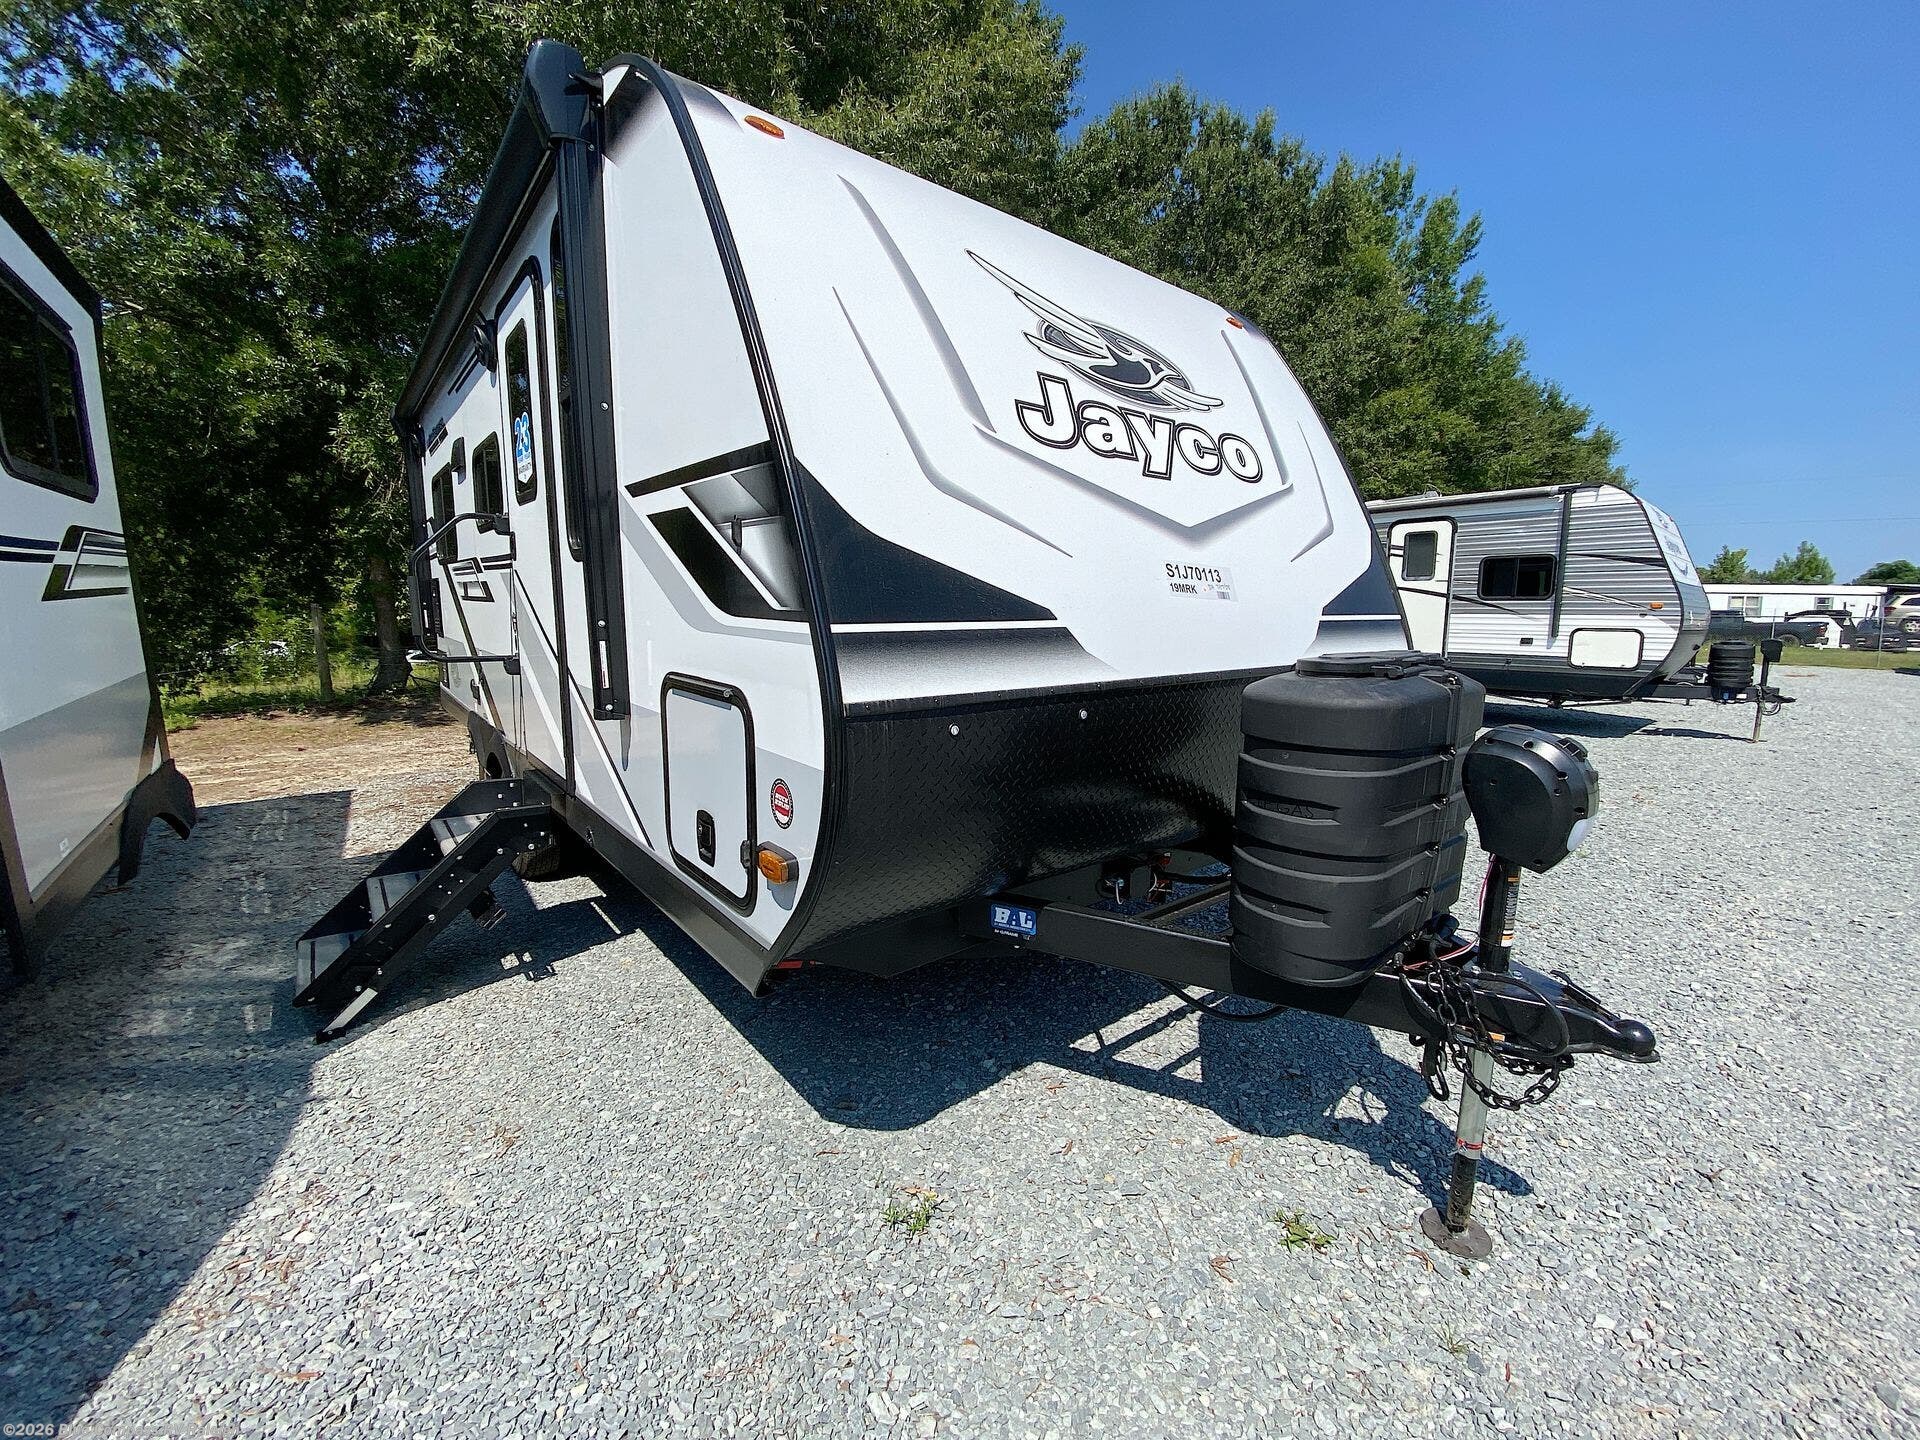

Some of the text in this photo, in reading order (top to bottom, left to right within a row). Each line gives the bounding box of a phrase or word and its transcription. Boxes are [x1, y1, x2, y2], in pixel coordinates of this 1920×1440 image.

[1015, 371, 1263, 483] Jayco
[1165, 563, 1222, 583] S1J70113
[1170, 582, 1198, 594] 19MRK
